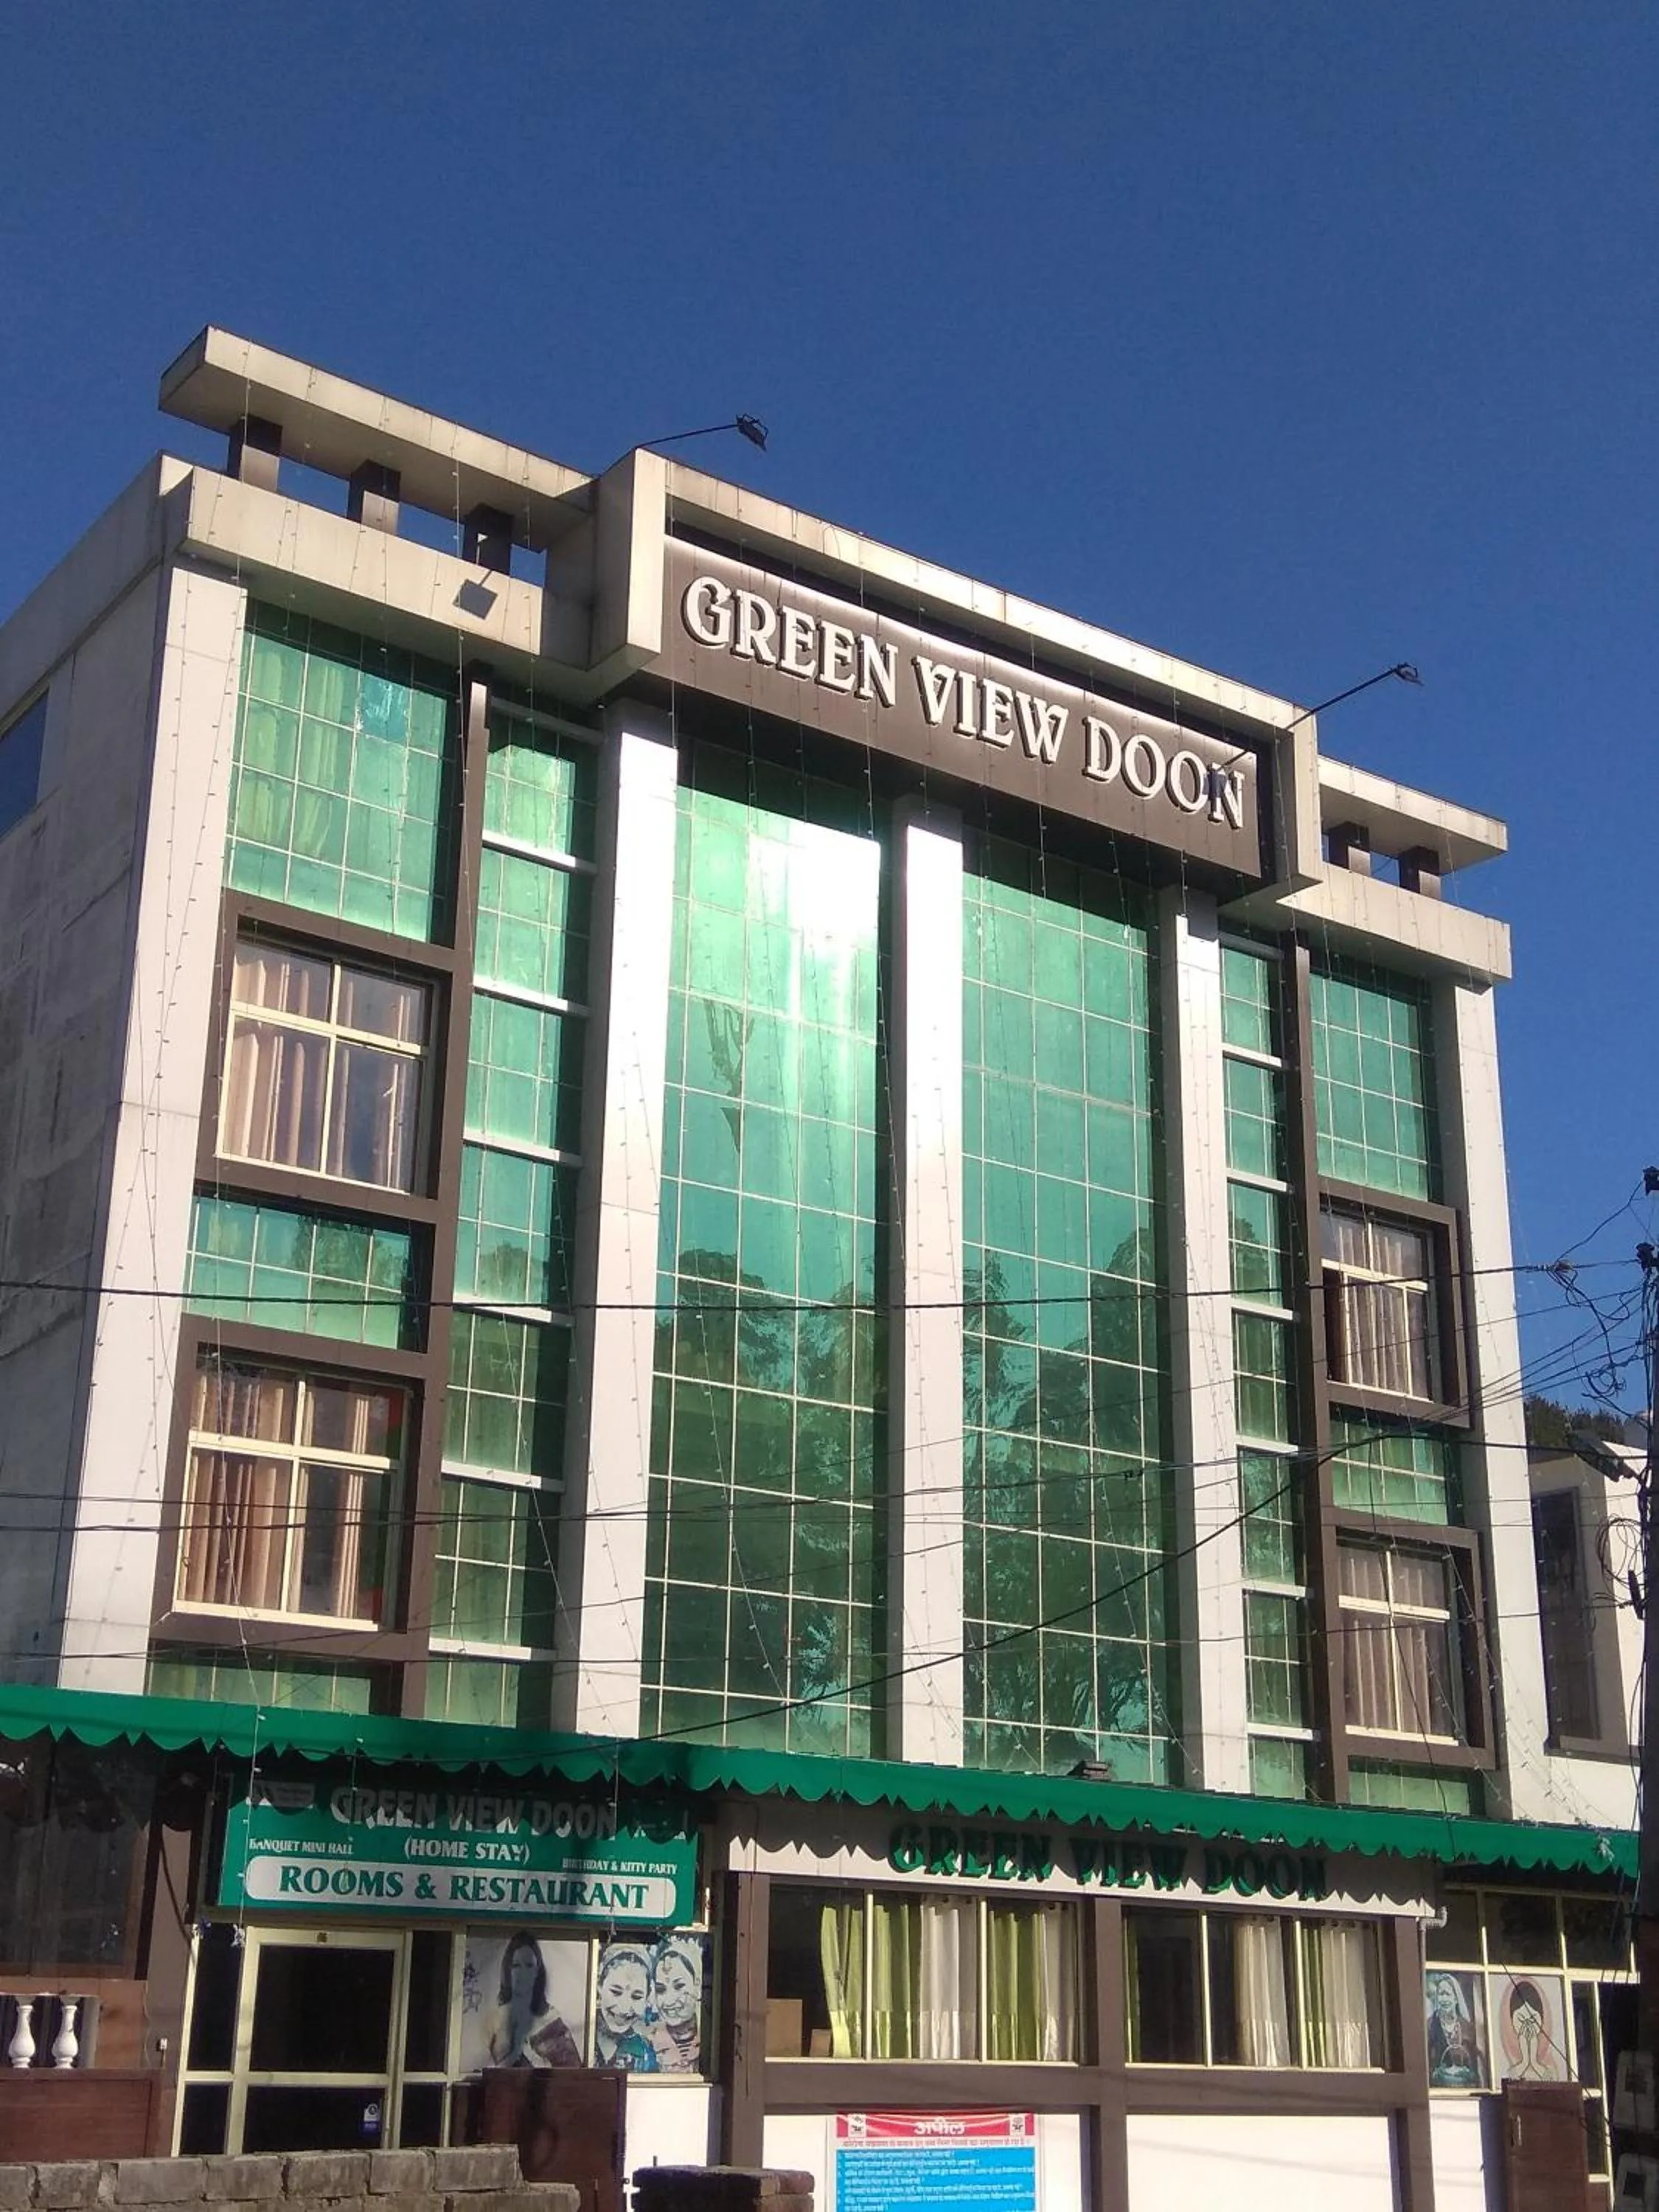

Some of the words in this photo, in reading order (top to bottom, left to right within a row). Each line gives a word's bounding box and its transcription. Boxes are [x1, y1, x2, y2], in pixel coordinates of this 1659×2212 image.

[681, 575, 898, 708] GREEN
[914, 653, 1069, 765] VIEW
[1082, 714, 1245, 830] DOON
[330, 1786, 437, 1829] GREEN
[445, 1794, 525, 1834] VIEW
[531, 1799, 616, 1841] DOON
[248, 1838, 300, 1852] BANQUET
[302, 1841, 325, 1853] MINI
[328, 1843, 354, 1854] HALL
[405, 1836, 470, 1859] (HOME
[476, 1841, 532, 1865] STAY)
[563, 1857, 608, 1871] BIRTHDAY
[611, 1860, 618, 1871] &
[621, 1862, 647, 1873] KITTY
[649, 1863, 678, 1874] PARTY
[888, 1823, 1052, 1882] GREEN
[1069, 1835, 1188, 1891] VIEW
[1203, 1849, 1327, 1902] DOON
[279, 1865, 404, 1898] ROOMS
[414, 1874, 437, 1899] &
[451, 1874, 650, 1910] RESTAURANT
